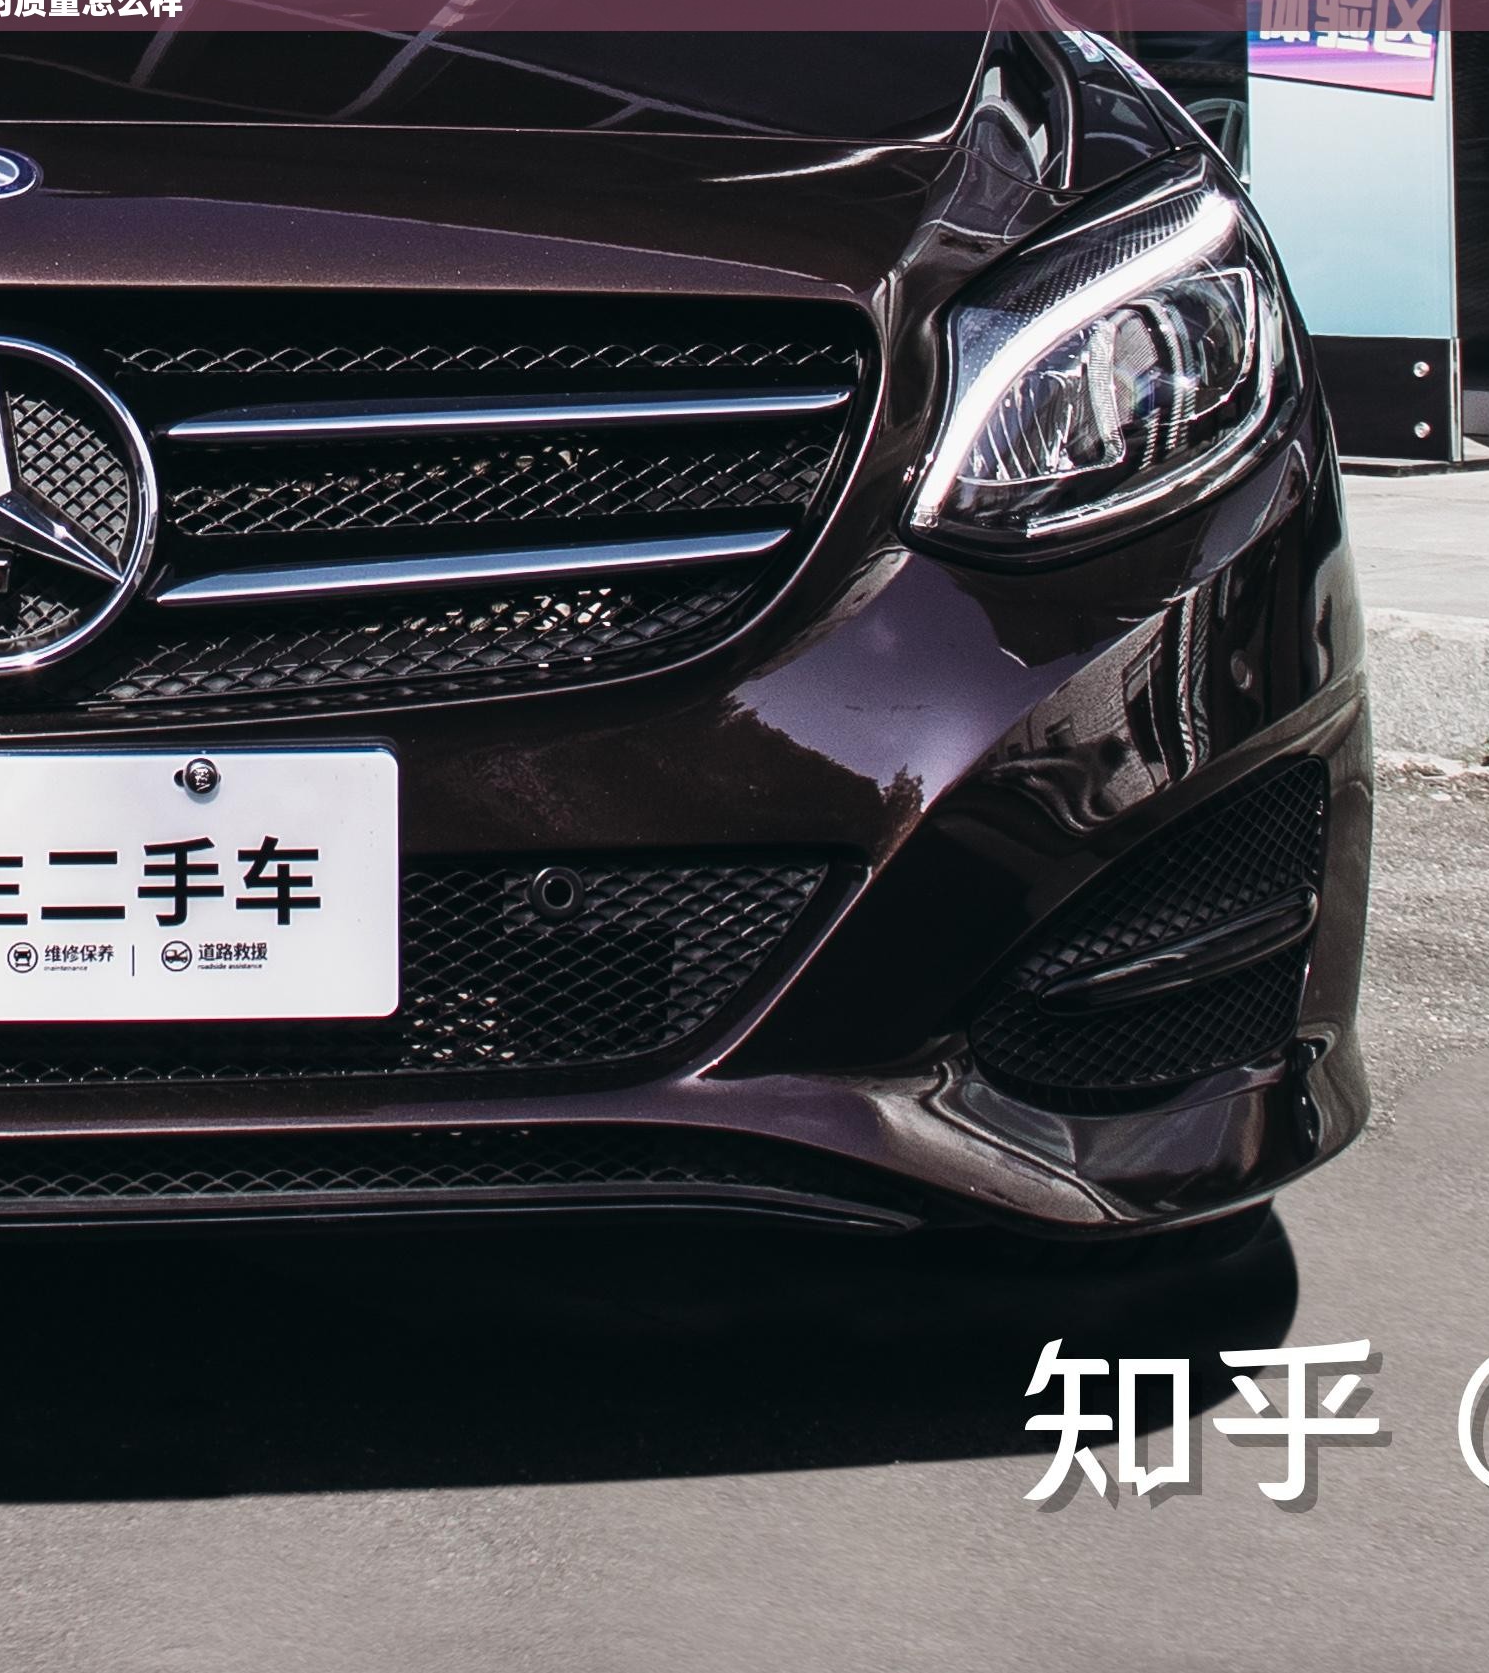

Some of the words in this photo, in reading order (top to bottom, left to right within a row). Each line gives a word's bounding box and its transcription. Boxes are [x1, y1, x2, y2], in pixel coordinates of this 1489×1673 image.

[43, 944, 115, 963] 维修保养
[198, 942, 268, 962] 道路救援
